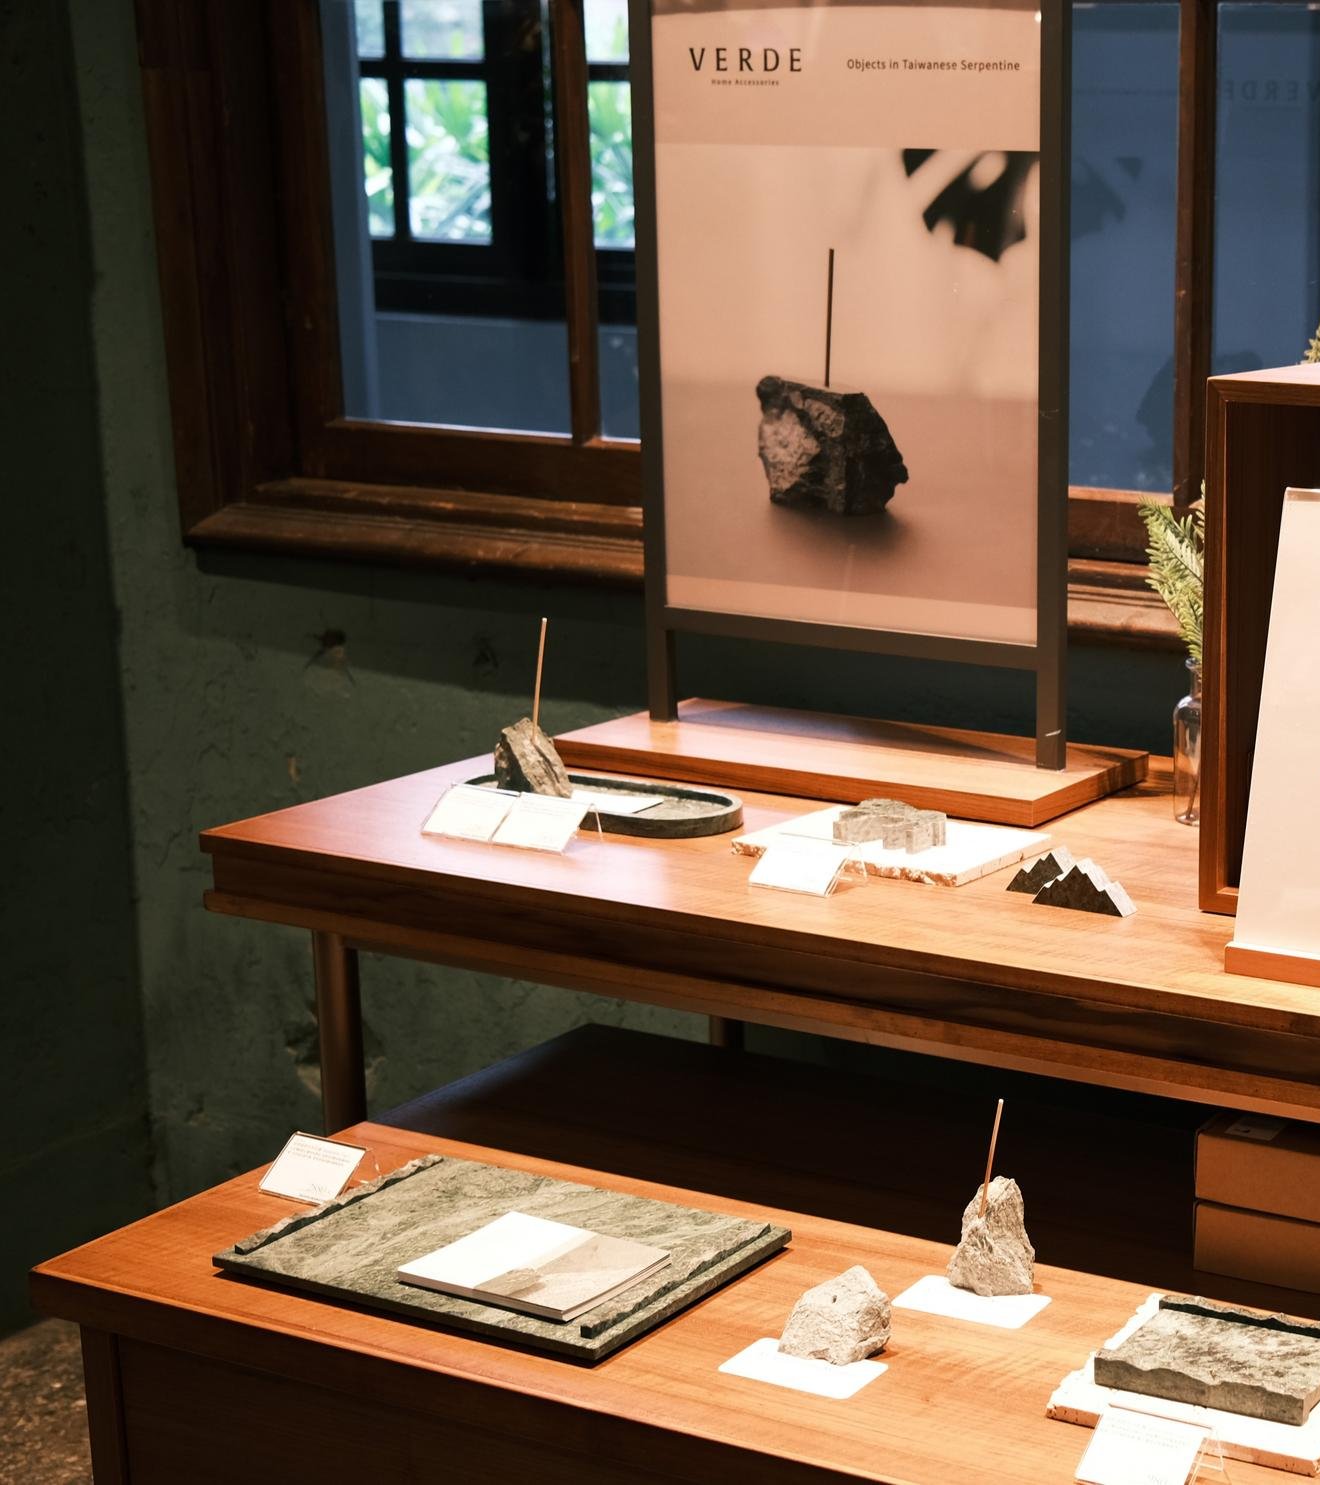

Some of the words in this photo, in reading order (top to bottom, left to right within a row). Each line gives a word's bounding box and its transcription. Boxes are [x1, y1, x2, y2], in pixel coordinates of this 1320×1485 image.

[688, 47, 802, 72] VERDE
[846, 58, 886, 72] Objects
[889, 58, 899, 70] in
[902, 59, 958, 71] Taiwanese
[960, 59, 1021, 74] Serpentine
[711, 78, 732, 86] Home
[735, 78, 780, 86] Accessories
